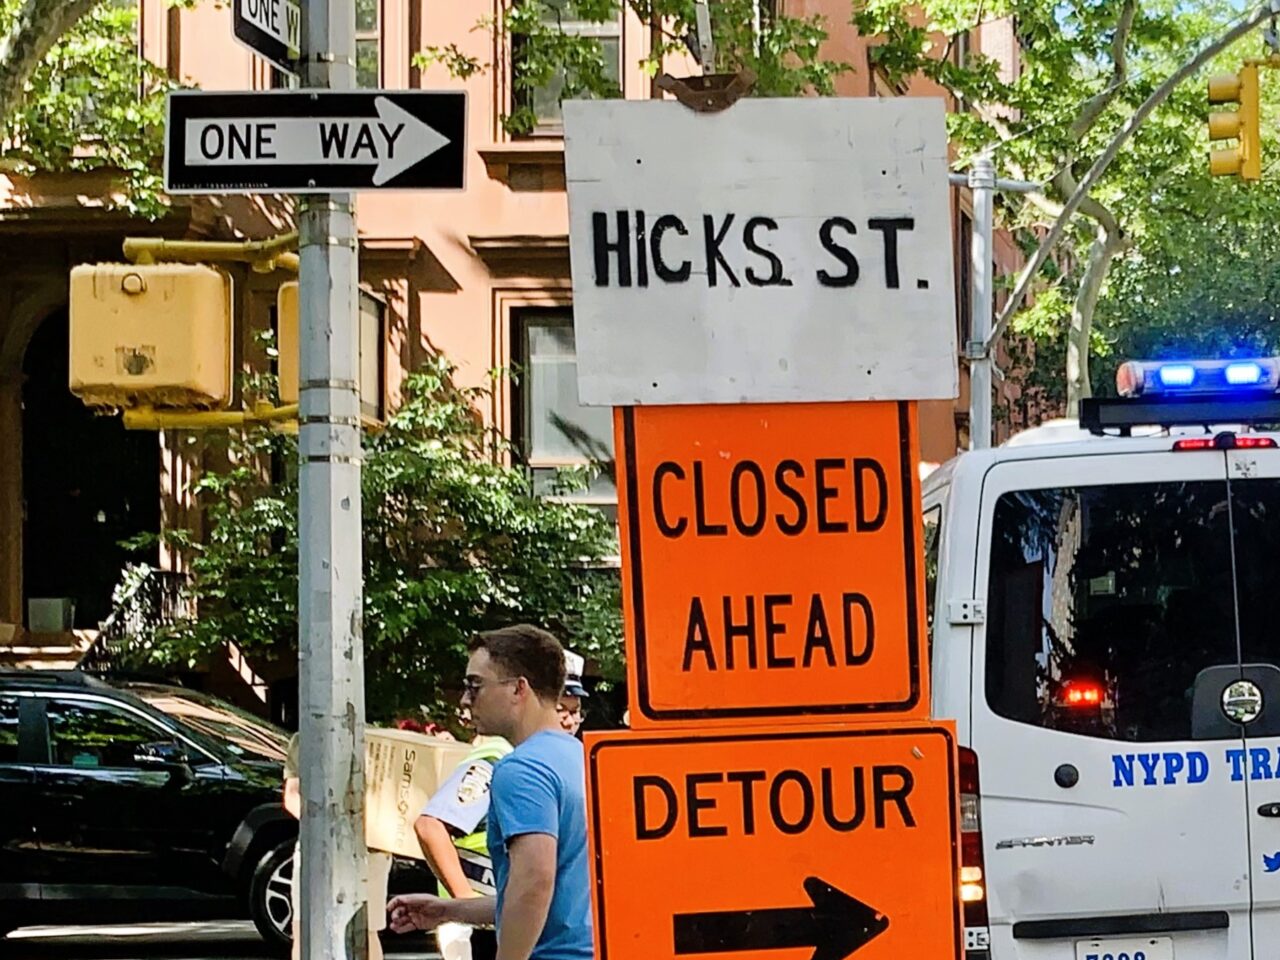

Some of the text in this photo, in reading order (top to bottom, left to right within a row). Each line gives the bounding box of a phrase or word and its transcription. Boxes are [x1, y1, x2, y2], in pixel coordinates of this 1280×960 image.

[248, 0, 281, 35] ONE
[200, 123, 406, 159] ONE WAY
[816, 217, 930, 290] ST.
[652, 457, 889, 540] CLOSED
[682, 591, 876, 672] AHEAD
[633, 764, 918, 842] DETOUR
[1111, 750, 1210, 788] NYPD
